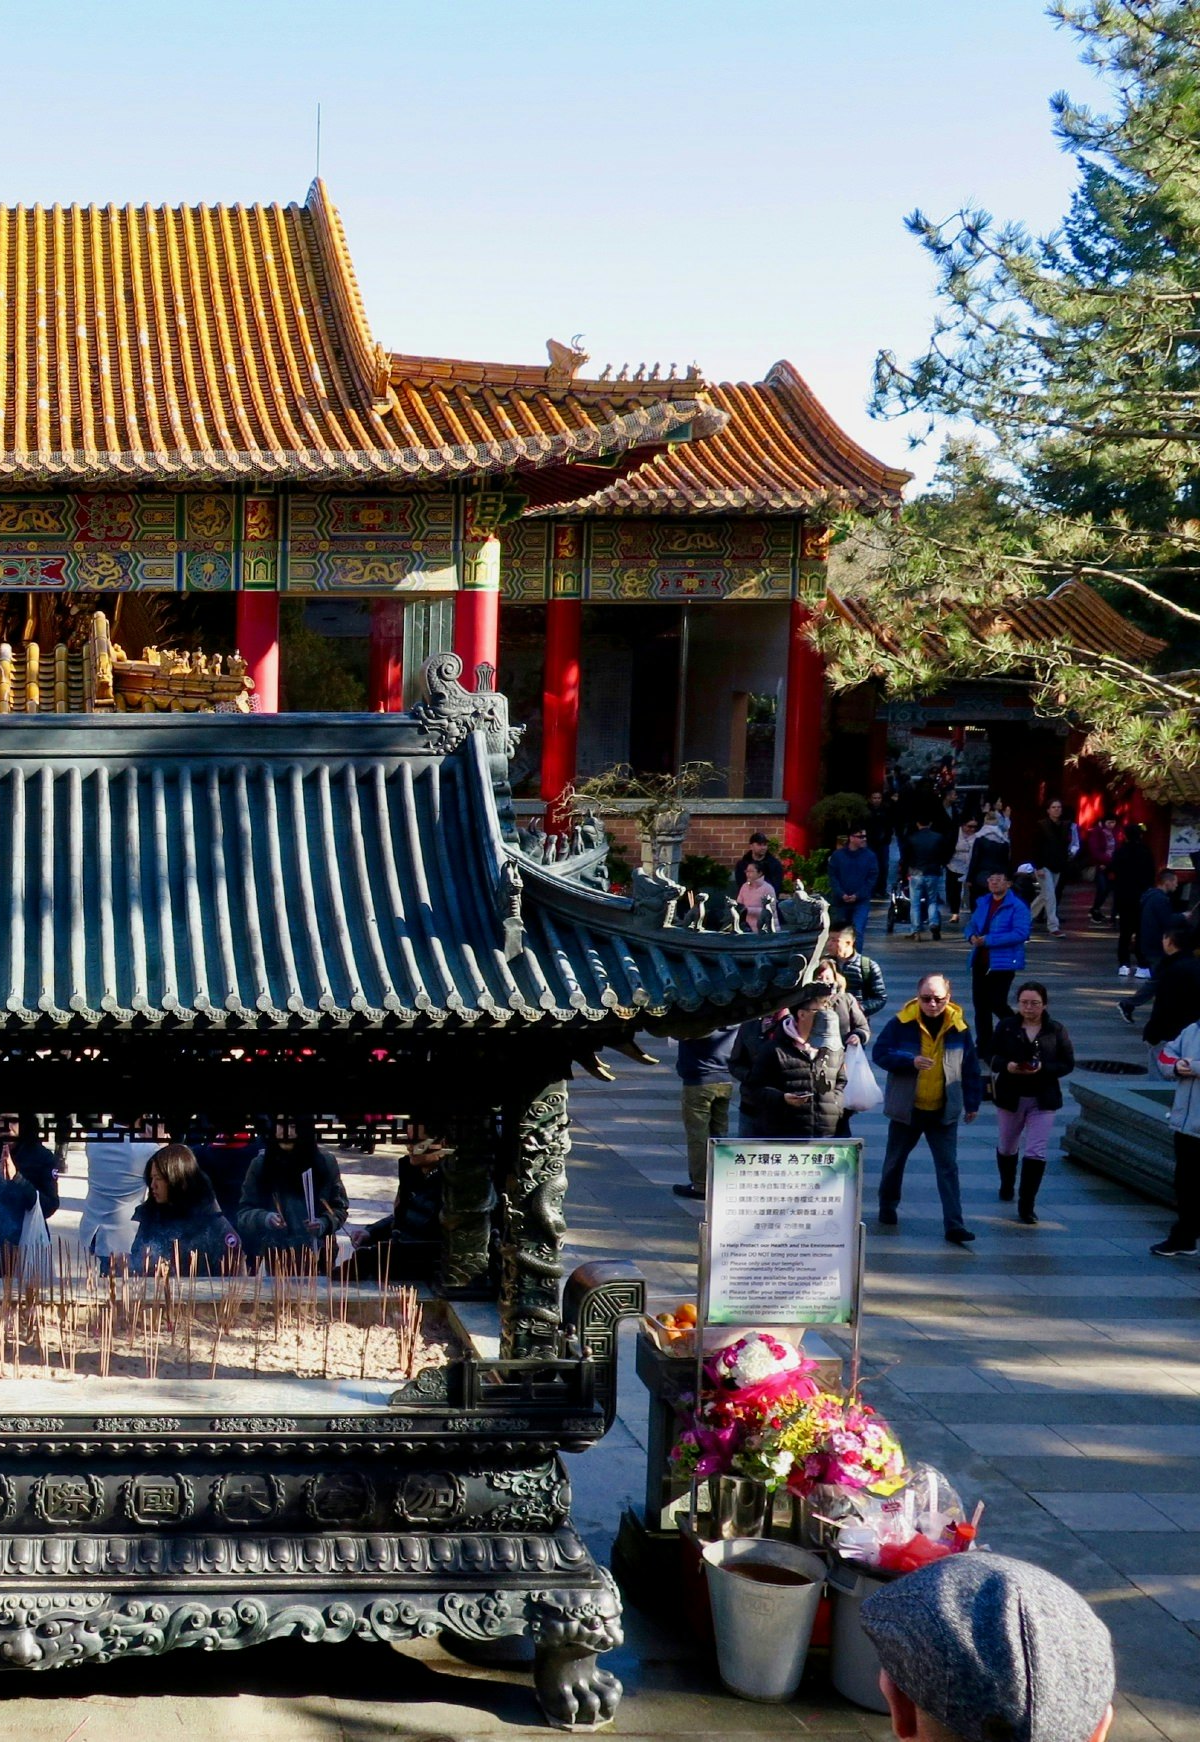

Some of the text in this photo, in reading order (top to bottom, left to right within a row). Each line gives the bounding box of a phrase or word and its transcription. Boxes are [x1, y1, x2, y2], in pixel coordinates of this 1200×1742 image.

[735, 1154, 835, 1165] 為了環保 為了健康
